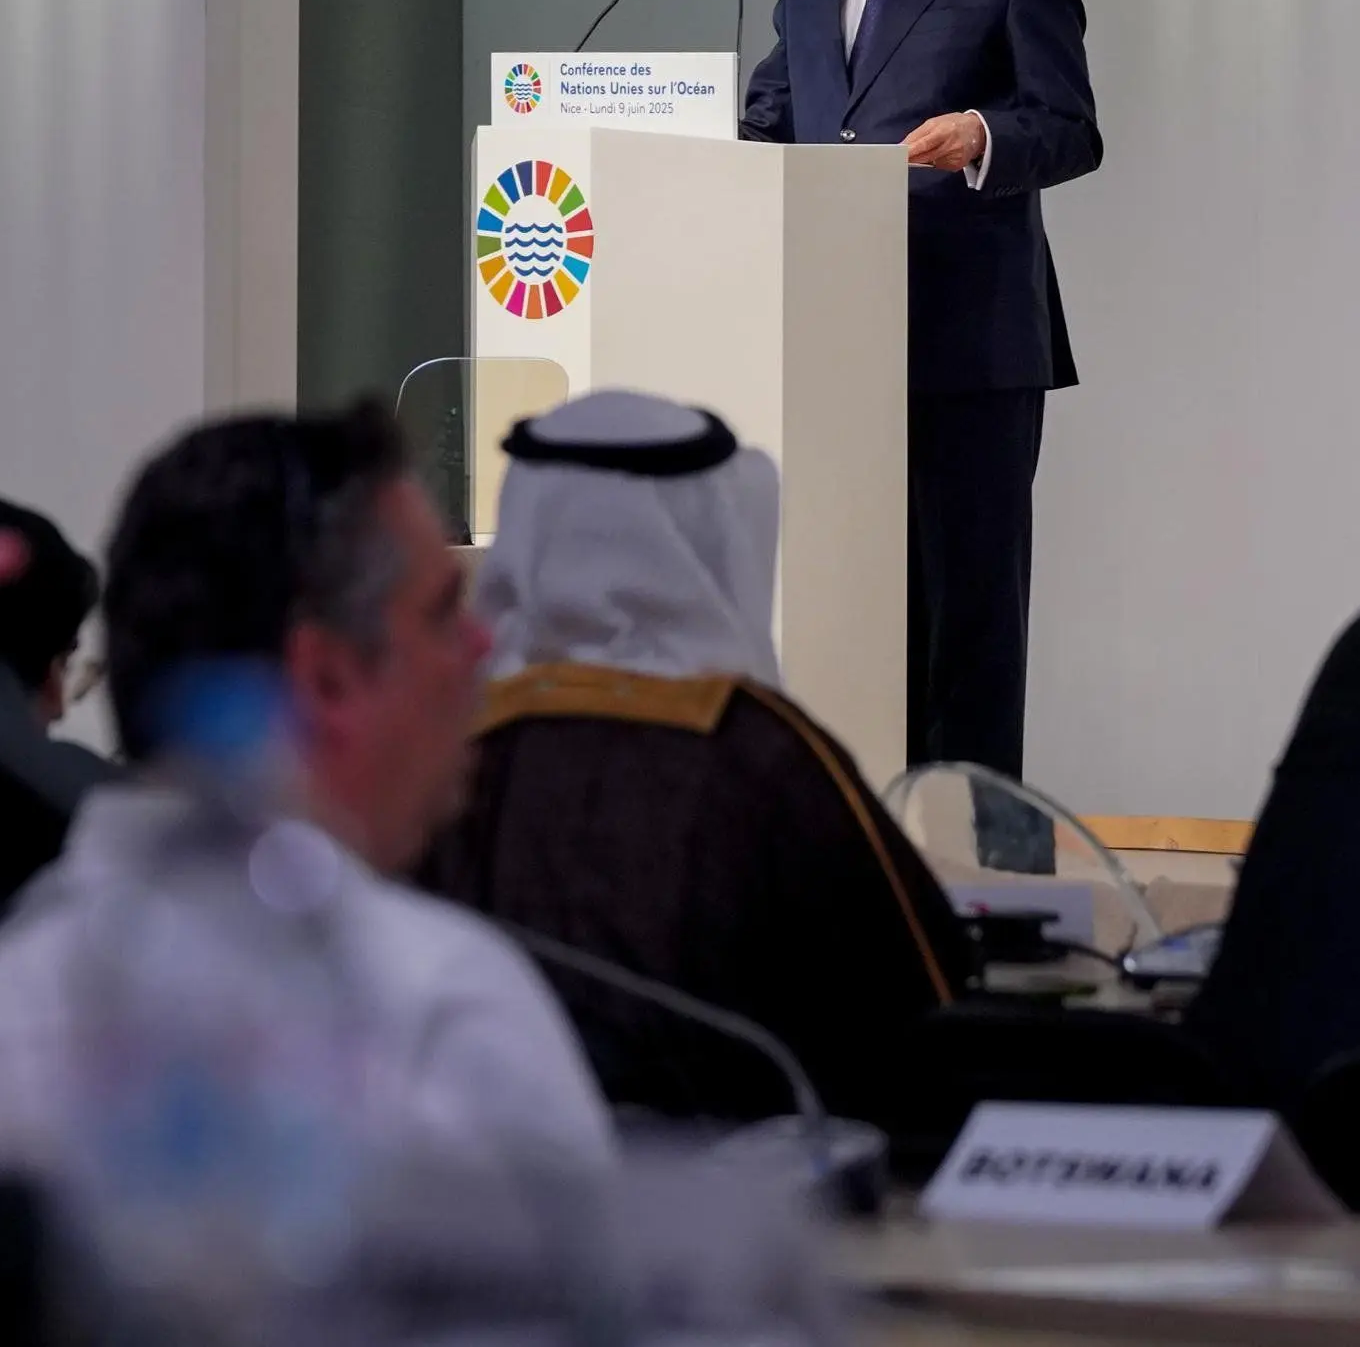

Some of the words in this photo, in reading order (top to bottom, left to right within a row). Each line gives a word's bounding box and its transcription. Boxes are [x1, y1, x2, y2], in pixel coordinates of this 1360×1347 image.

[560, 63, 626, 76] Conférence
[630, 63, 652, 76] des
[560, 81, 606, 95] Nations
[610, 81, 644, 95] Unies
[648, 85, 666, 95] sur
[560, 103, 581, 114] Nice
[590, 103, 616, 114] Lundi
[619, 103, 625, 114] 9
[627, 103, 646, 117] juin
[648, 103, 675, 114] 2025
